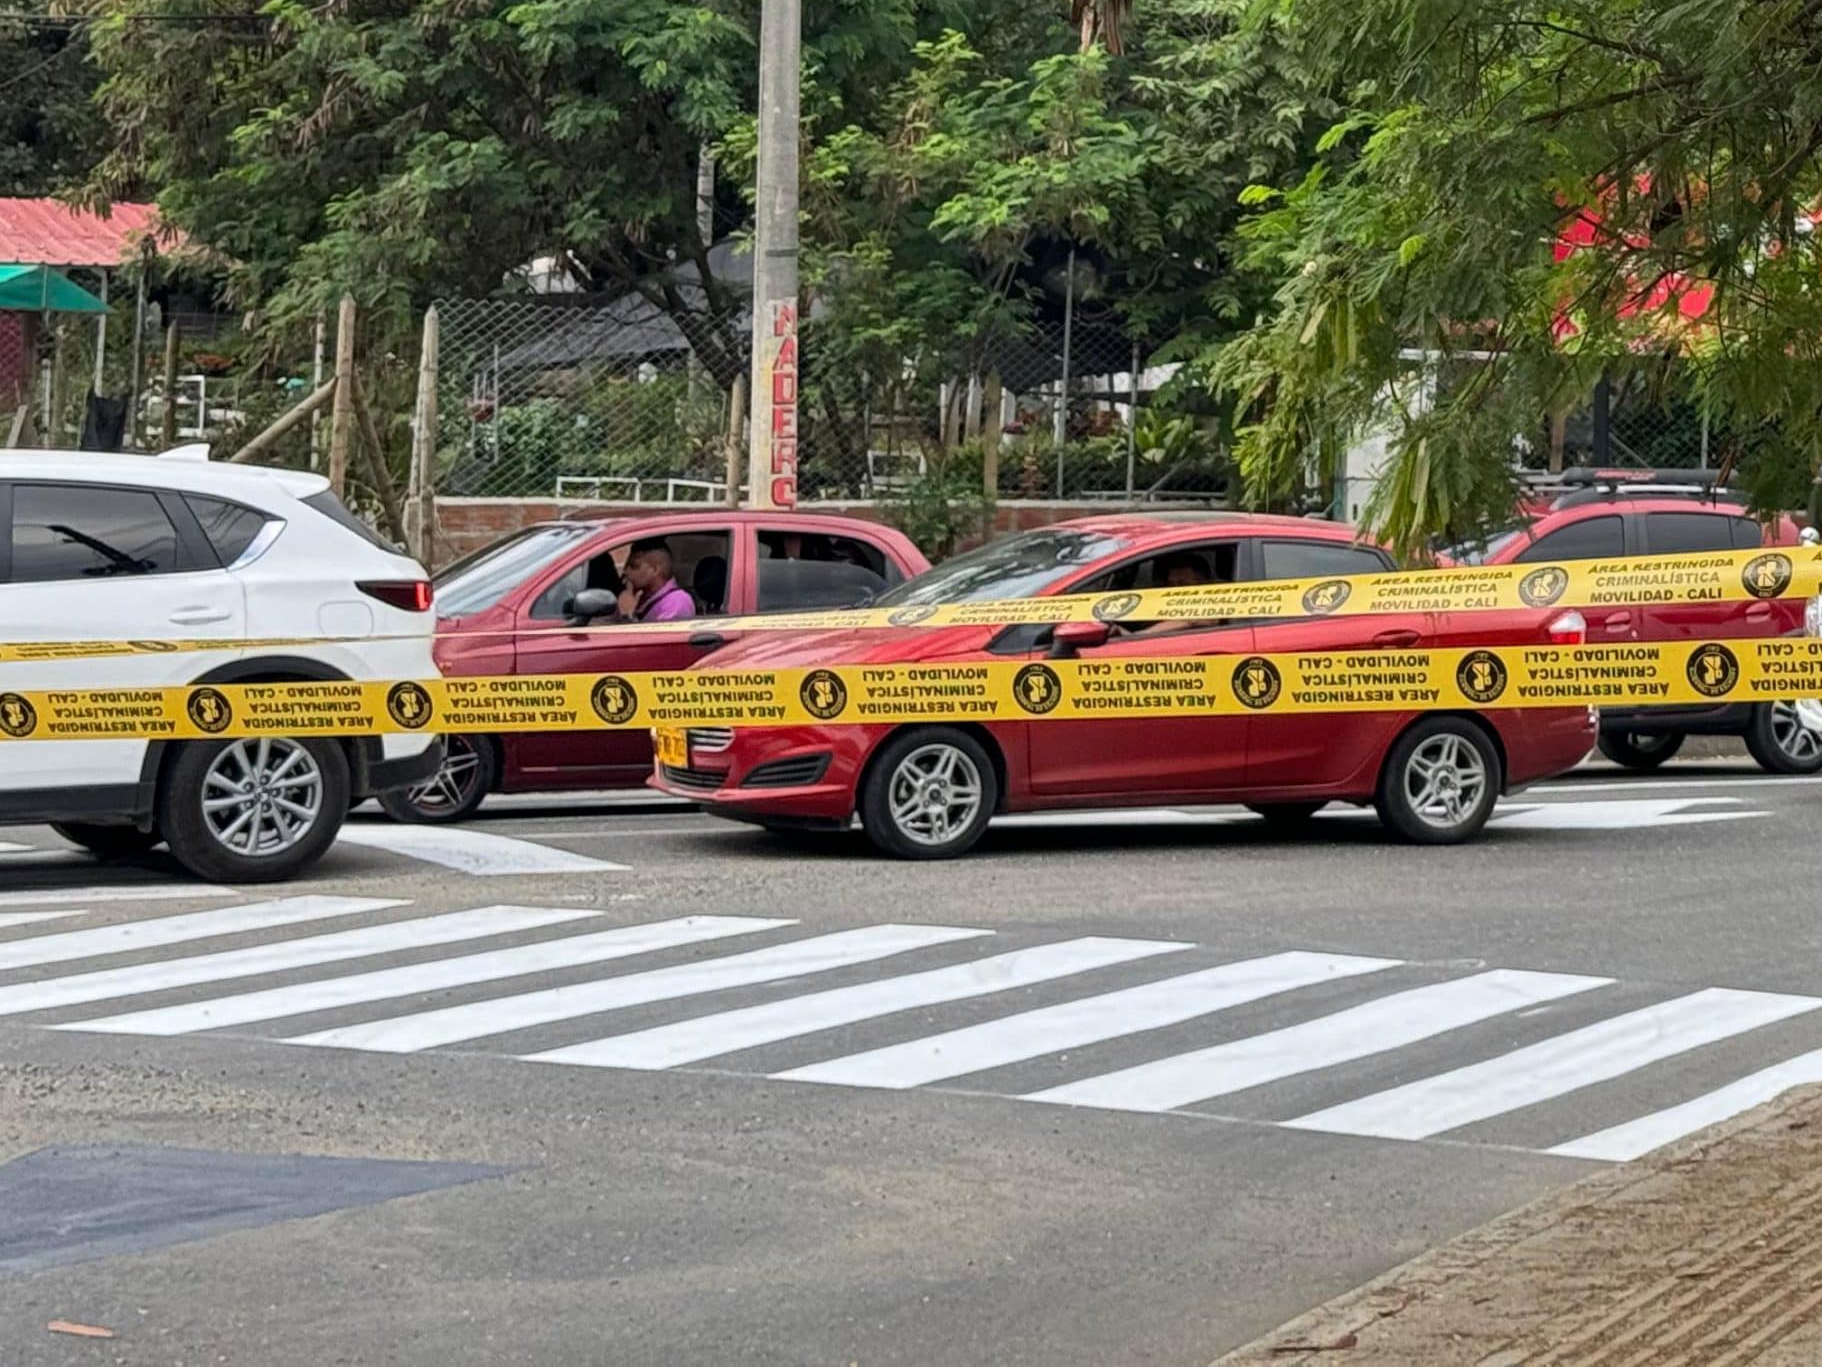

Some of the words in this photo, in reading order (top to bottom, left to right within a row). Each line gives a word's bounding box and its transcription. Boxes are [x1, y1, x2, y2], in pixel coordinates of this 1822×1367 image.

[1633, 558, 1734, 571] RESTRINGIDA
[1415, 571, 1512, 583] RESTRINGIDA
[1596, 572, 1720, 587] CRIMINALÍSTICA
[1378, 583, 1497, 597] CRIMINALÍSTICA
[1590, 590, 1673, 604] MOVILIDAD
[1687, 587, 1722, 600] CALI
[1370, 599, 1451, 610] MOVILIDAD
[1464, 597, 1497, 608] CALI
[1157, 607, 1235, 617] MOVILIDAD
[1248, 606, 1282, 615] CALI
[1574, 648, 1659, 662] MOVILIDAD
[1758, 644, 1793, 656] CALI
[1299, 657, 1332, 669] CALI
[1346, 655, 1429, 668] MOVILIDAD
[1525, 651, 1559, 663] CALI
[908, 668, 987, 680] MOVILIDAD
[1079, 664, 1111, 675] CALI
[1125, 662, 1206, 674] MOVILIDAD
[1528, 666, 1656, 681] CRIMINALÍSTICA
[698, 674, 774, 686] MOVILIDAD
[863, 670, 895, 681] CALI
[1302, 672, 1426, 687] CRIMINALÍSTICA
[446, 682, 477, 693] CALI
[490, 680, 566, 692] MOVILIDAD
[653, 676, 684, 688] CALI
[1082, 678, 1203, 693] CRIMINALÍSTICA
[245, 688, 275, 698] CALI
[287, 686, 361, 697] MOVILIDAD
[867, 684, 985, 699] CRIMINALÍSTICA
[1399, 689, 1439, 703] ÁREA
[1518, 684, 1622, 697] RESTRINGIDA
[1628, 683, 1669, 697] ÁREA
[48, 693, 78, 703] CALI
[90, 692, 162, 703] MOVILIDAD
[657, 691, 772, 704] CRIMINALÍSTICA
[1072, 696, 1171, 709] RESTRINGIDA
[1176, 695, 1216, 709] ÁREA
[1292, 690, 1394, 703] RESTRINGIDA
[648, 707, 743, 719] RESTRINGIDA
[858, 701, 954, 714] RESTRINGIDA
[959, 701, 997, 715] ÁREA
[243, 717, 333, 728] RESTRINGIDA
[443, 712, 536, 724] RESTRINGIDA
[48, 721, 136, 732] RESTRINGIDA
